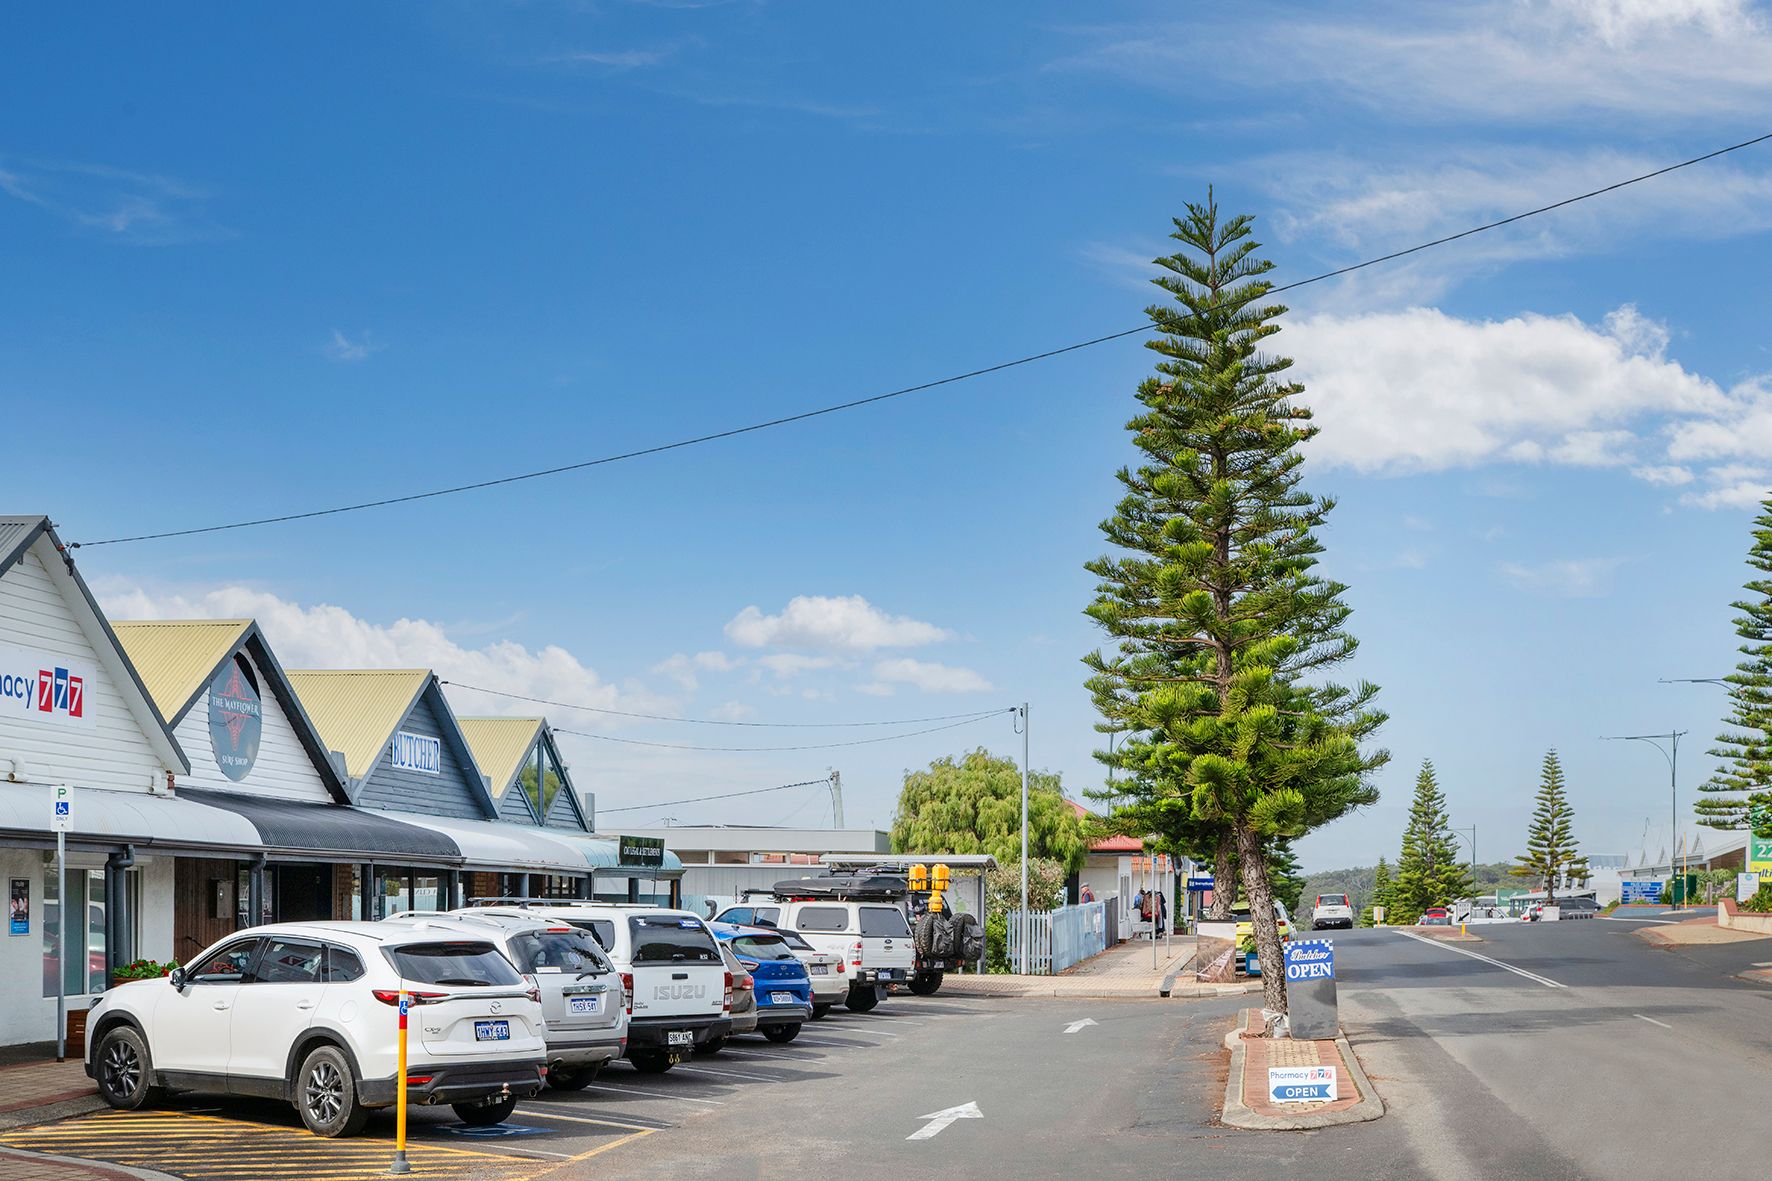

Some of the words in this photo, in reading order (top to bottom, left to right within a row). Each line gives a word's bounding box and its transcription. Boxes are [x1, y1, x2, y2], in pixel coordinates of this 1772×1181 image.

[0, 674, 34, 709] acy
[40, 674, 82, 712] 777
[212, 696, 224, 708] THE
[225, 697, 260, 716] MAYFLOWER
[393, 734, 439, 771] BUTCHER
[222, 755, 233, 766] SURF
[235, 757, 248, 766] SHOP
[58, 788, 67, 799] P
[1290, 949, 1331, 961] Butcher
[1287, 962, 1332, 979] OPEN
[653, 985, 706, 1000] ISUZU
[1270, 1071, 1309, 1080] Pharmacy
[1310, 1069, 1332, 1080] 777
[1285, 1087, 1318, 1098] OPEN
